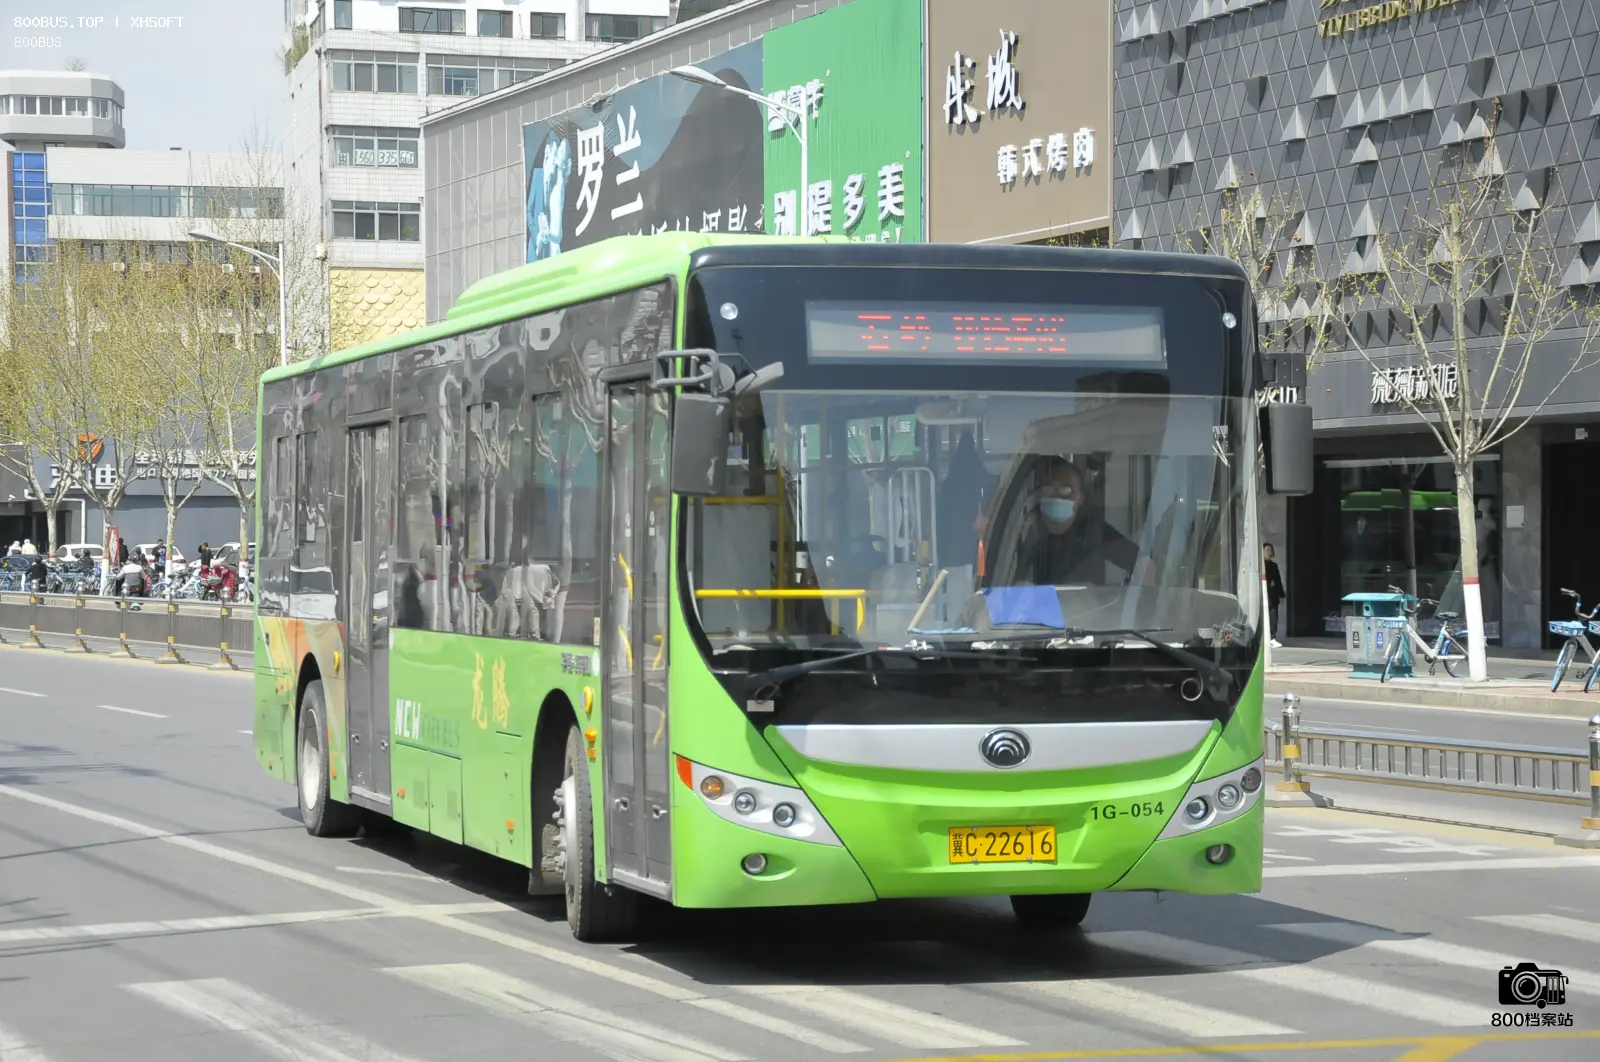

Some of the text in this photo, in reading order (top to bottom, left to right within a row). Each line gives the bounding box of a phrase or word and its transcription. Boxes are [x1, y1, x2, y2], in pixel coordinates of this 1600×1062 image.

[574, 104, 644, 237] 罗兰
[394, 698, 421, 740] NEW
[1090, 801, 1165, 821] 1G-054
